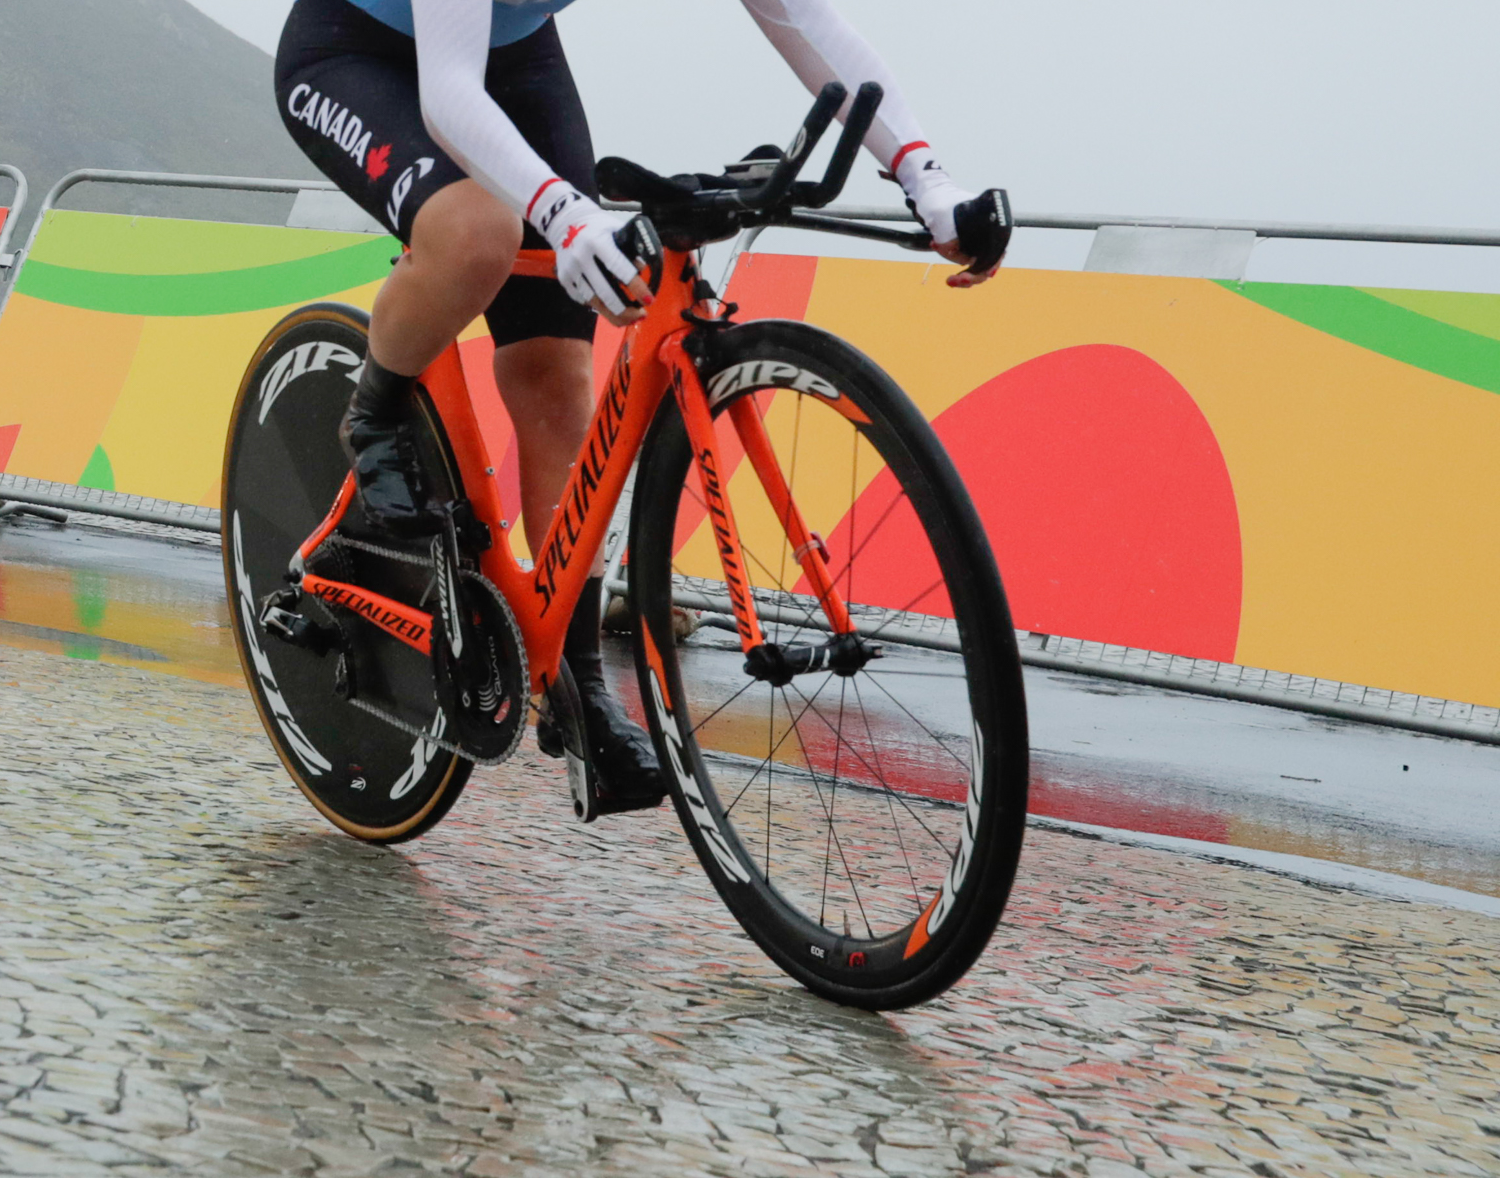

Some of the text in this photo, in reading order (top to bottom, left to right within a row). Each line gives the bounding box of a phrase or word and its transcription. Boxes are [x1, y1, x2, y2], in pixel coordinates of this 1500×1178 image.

[288, 83, 373, 168] CANADA
[534, 341, 632, 619] SPECIALIZED
[707, 359, 841, 410] ZIPP
[313, 582, 427, 642] SPECIALIZED
[700, 446, 754, 640] SPECIALIZED
[233, 509, 333, 776] ZIPP
[650, 668, 752, 884] ZIPP
